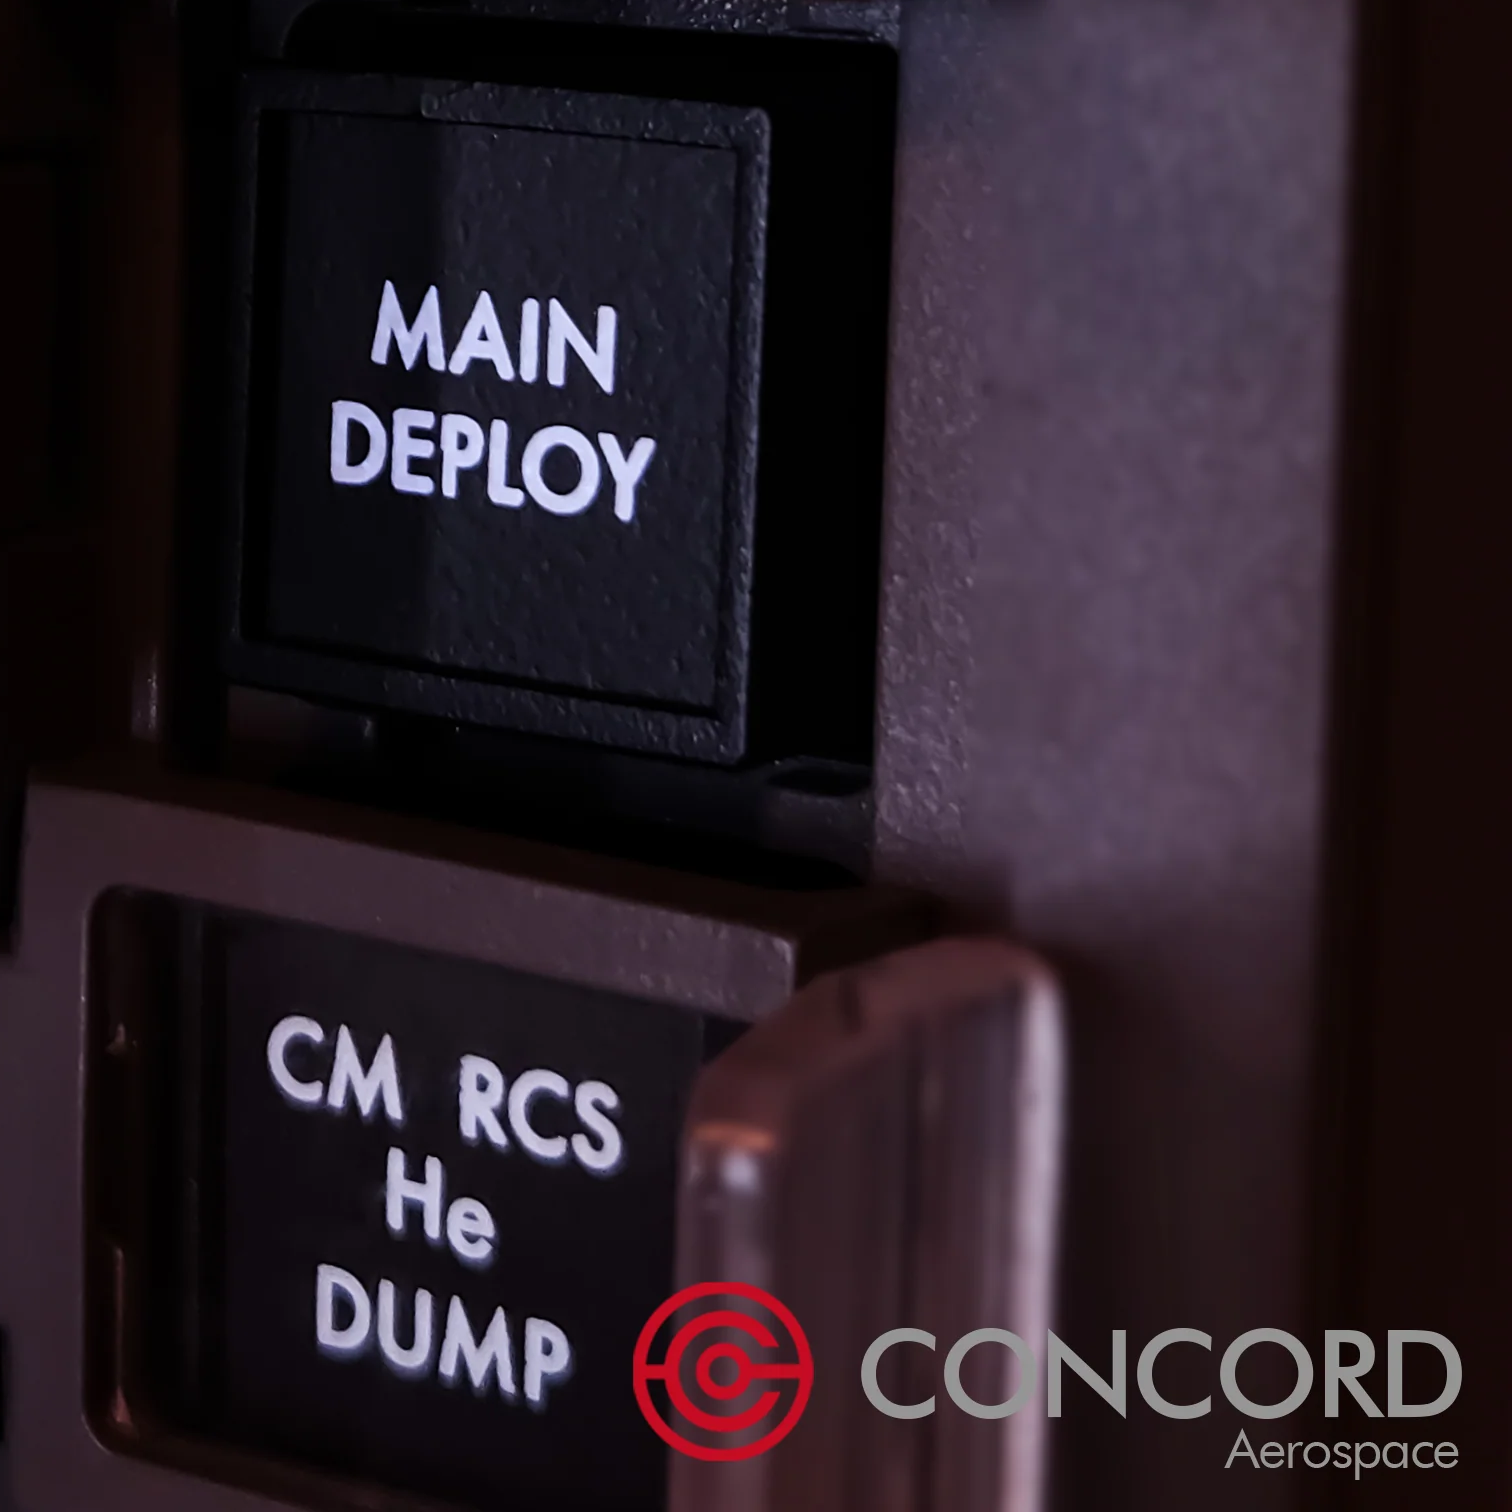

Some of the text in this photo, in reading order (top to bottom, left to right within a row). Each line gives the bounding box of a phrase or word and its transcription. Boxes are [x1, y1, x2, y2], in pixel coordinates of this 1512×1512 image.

[370, 279, 618, 396] MAIN
[330, 399, 657, 524] DEPLOY
[266, 1014, 624, 1172] CM RCS
[386, 1146, 498, 1264] He
[315, 1263, 573, 1404] DUMP
